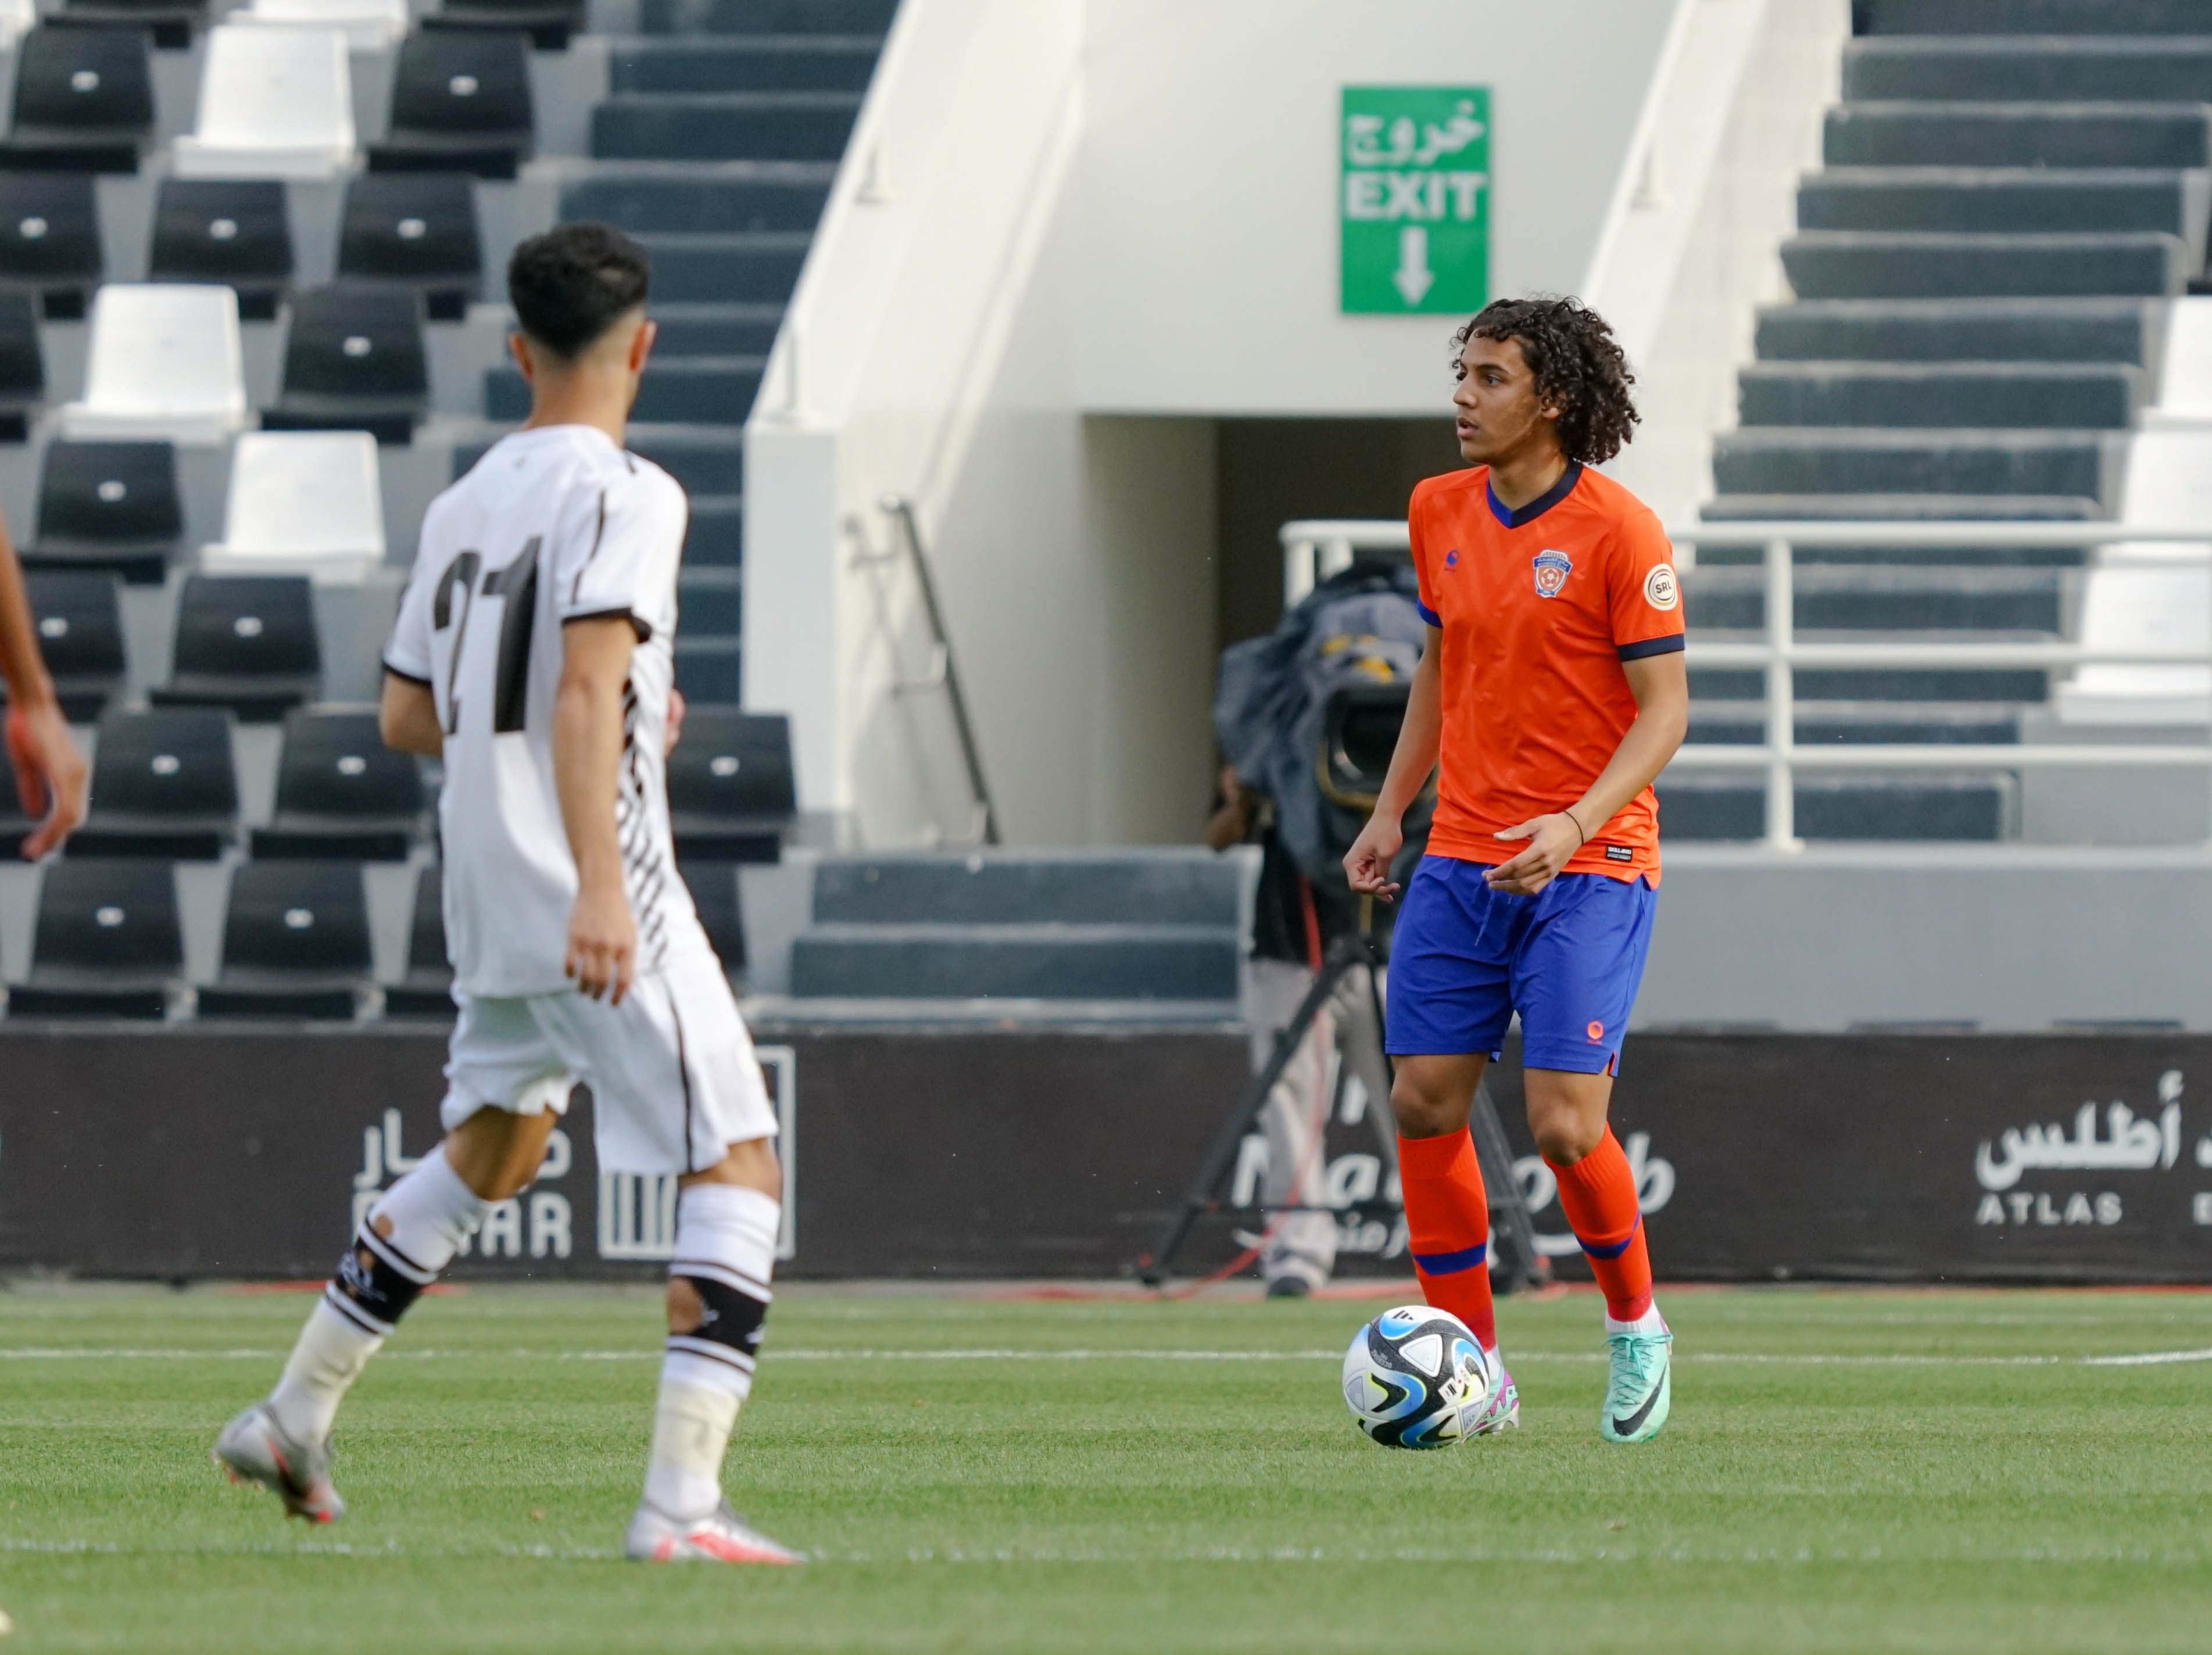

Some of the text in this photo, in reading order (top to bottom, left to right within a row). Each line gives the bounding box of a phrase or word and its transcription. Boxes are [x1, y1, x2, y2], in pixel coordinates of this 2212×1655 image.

[1345, 99, 1485, 166] خروج
[1346, 171, 1487, 220] EXIT
[1655, 581, 1672, 594] SRL
[432, 535, 543, 735] 21
[1975, 1069, 2184, 1191] أطلس
[1976, 1191, 2122, 1226] ATLAS
